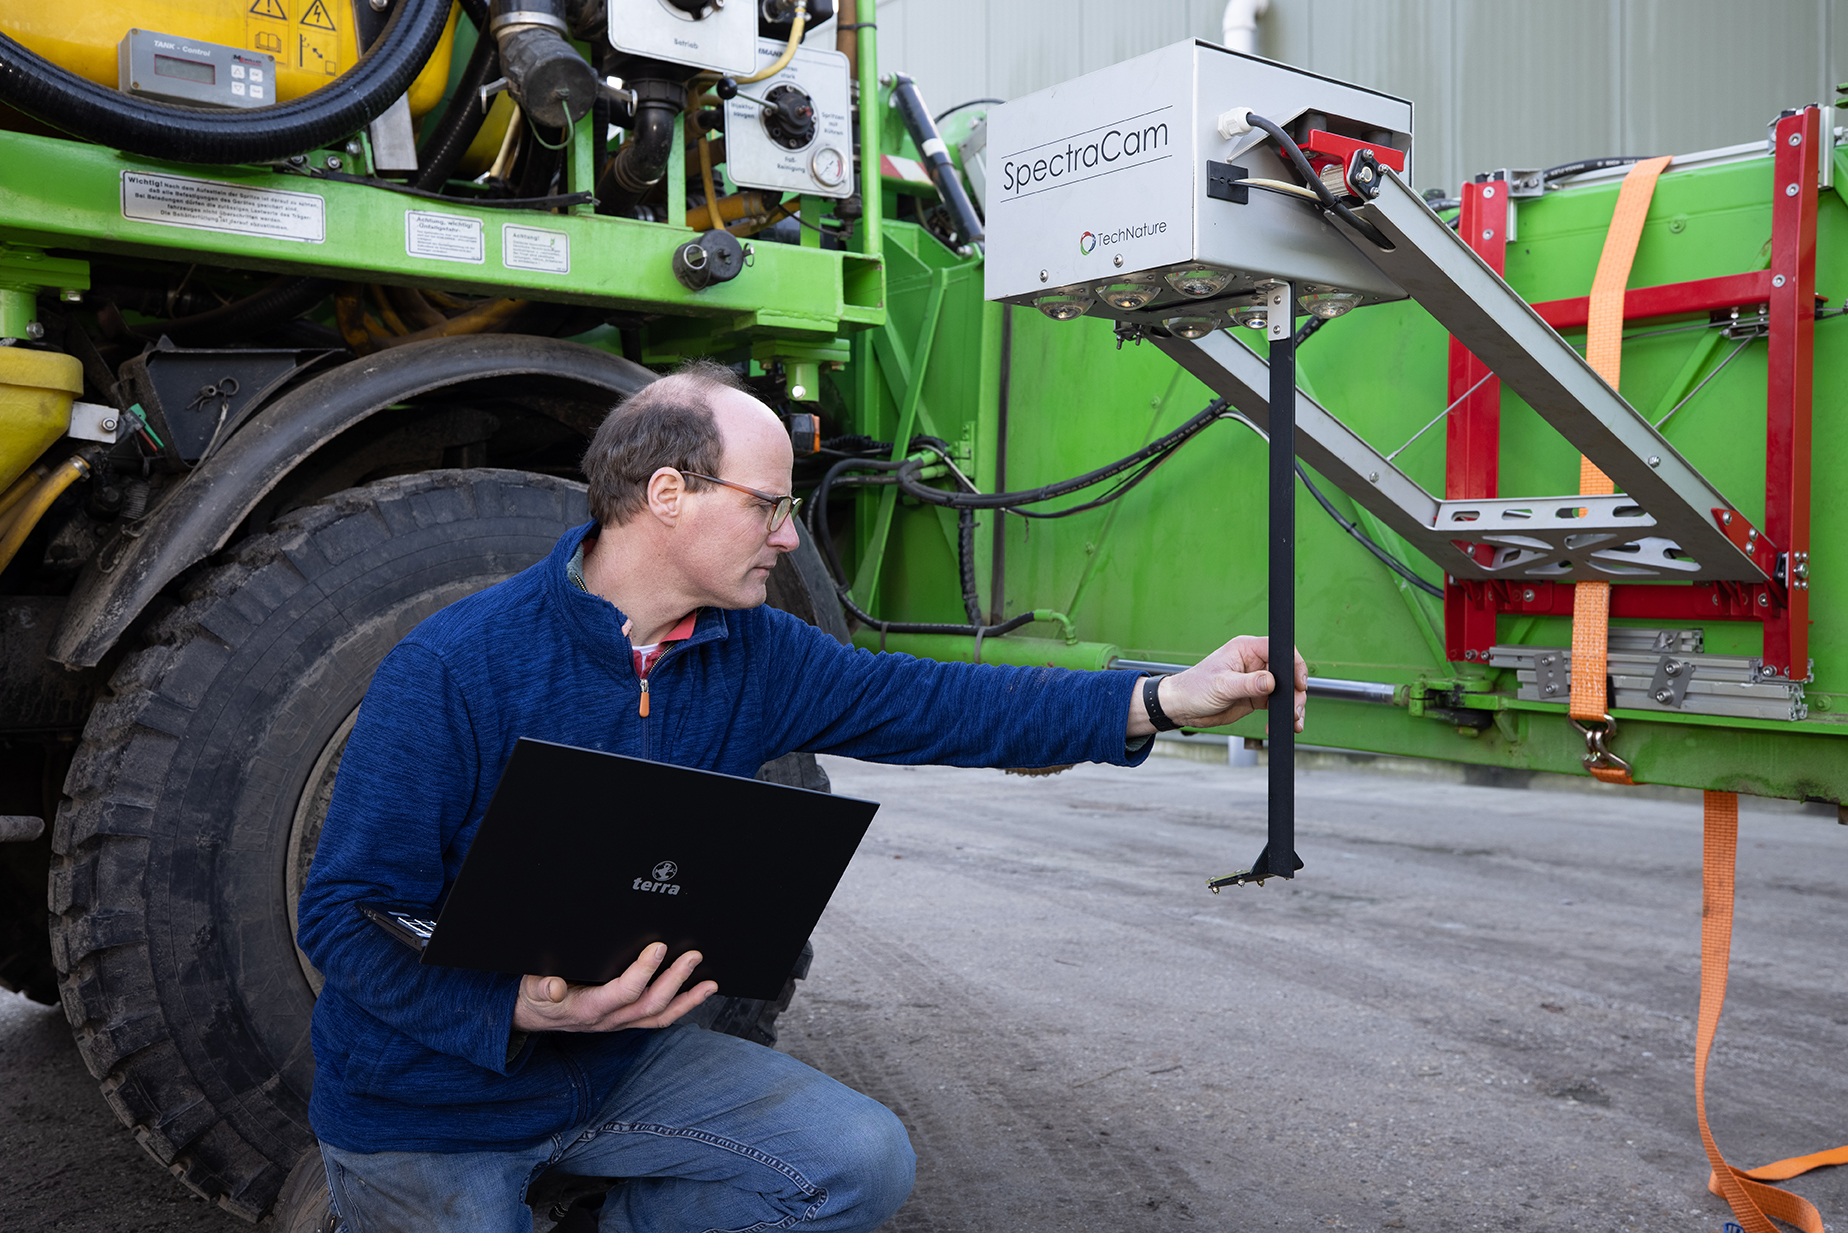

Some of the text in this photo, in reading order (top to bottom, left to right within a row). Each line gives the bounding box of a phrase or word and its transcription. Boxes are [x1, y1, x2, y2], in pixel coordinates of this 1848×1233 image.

[154, 40, 175, 50] TANK
[182, 46, 211, 57] Control
[1003, 123, 1168, 194] SpectraCam
[128, 176, 163, 188] Wichtig!
[147, 194, 184, 204] Beladungen
[175, 191, 218, 201] Befestigungen
[167, 204, 201, 212] fahrzeuges
[417, 217, 446, 225] Achtung,
[513, 233, 540, 241] Achtung!
[1098, 221, 1167, 246] TechNature
[632, 877, 681, 895] terra
